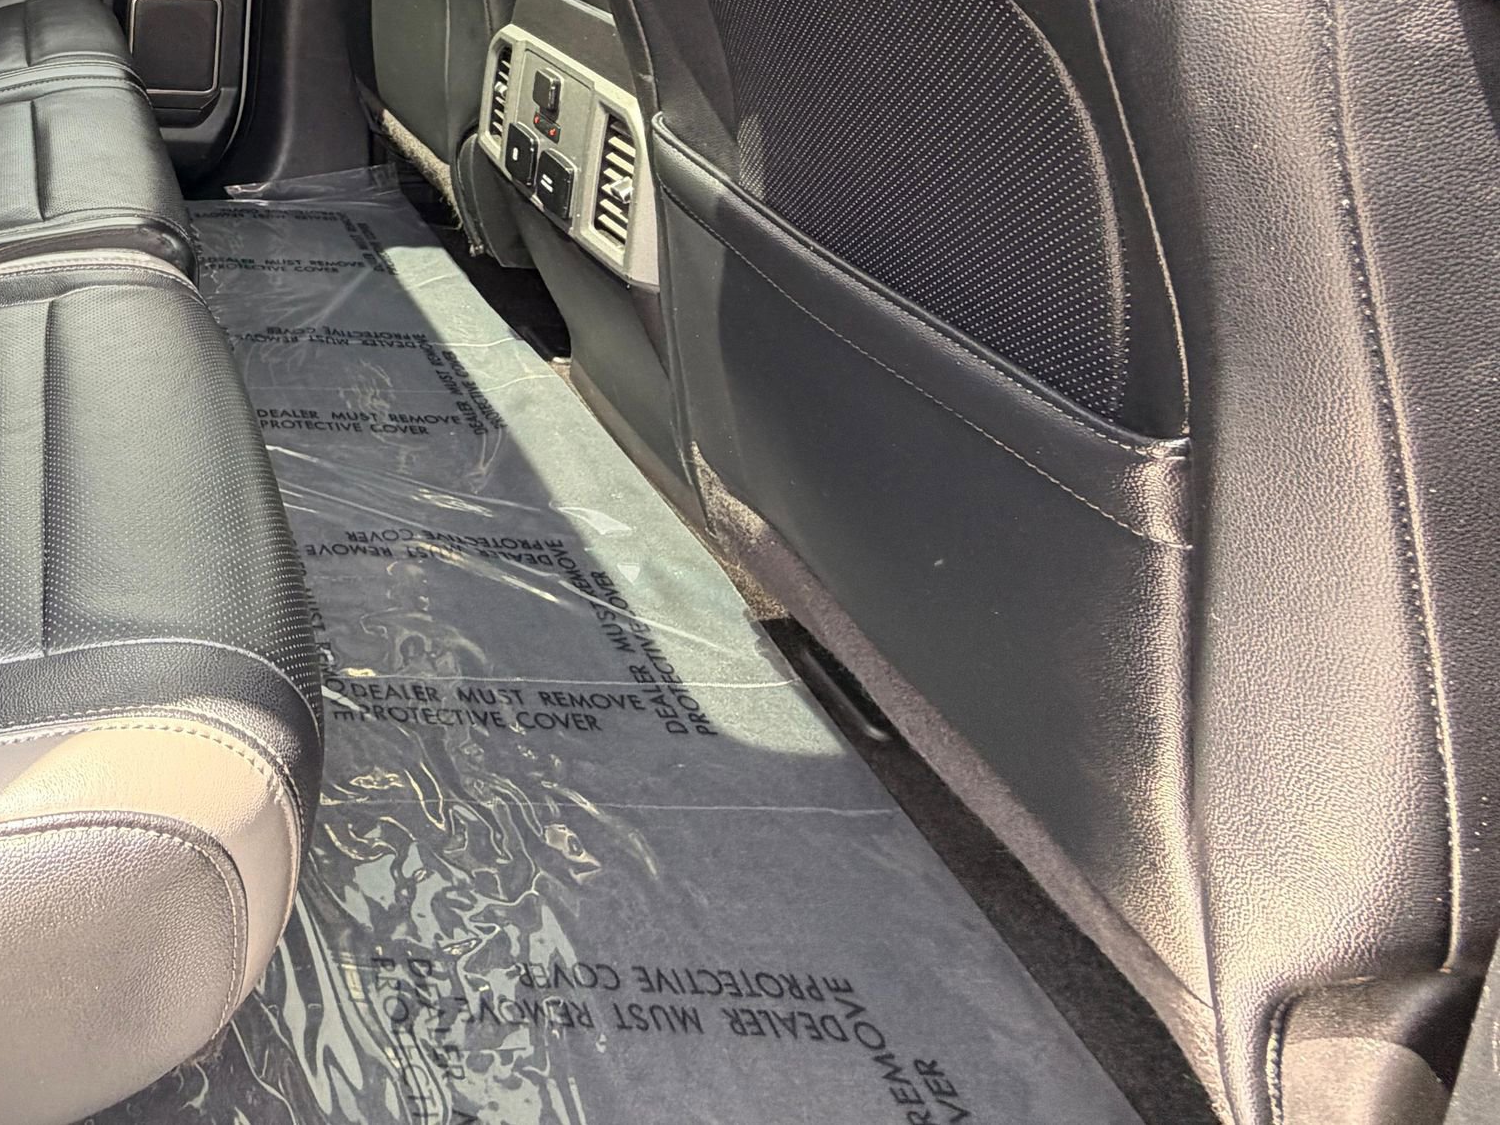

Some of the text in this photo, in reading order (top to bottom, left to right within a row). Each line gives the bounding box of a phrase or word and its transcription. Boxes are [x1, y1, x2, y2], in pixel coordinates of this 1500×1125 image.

[310, 335, 349, 346] MUST
[256, 408, 462, 424] DEALER MUST REMOVE
[260, 419, 429, 435] PROTECTIVE COVER
[306, 544, 393, 557] REMOVE
[346, 529, 551, 551] PROTECTIVE COVER
[475, 547, 553, 566] DEALER
[589, 599, 636, 653] MUST
[629, 623, 718, 735] PROTECTIVE
[350, 683, 646, 711] DEALER MUST REMOVE
[628, 664, 689, 734] DEALER
[360, 705, 602, 731] PROTECTIVE COVER
[520, 962, 825, 1001] PROTECTIVE COVER
[614, 1003, 704, 1035] MUST
[722, 1006, 850, 1042] DEALER
